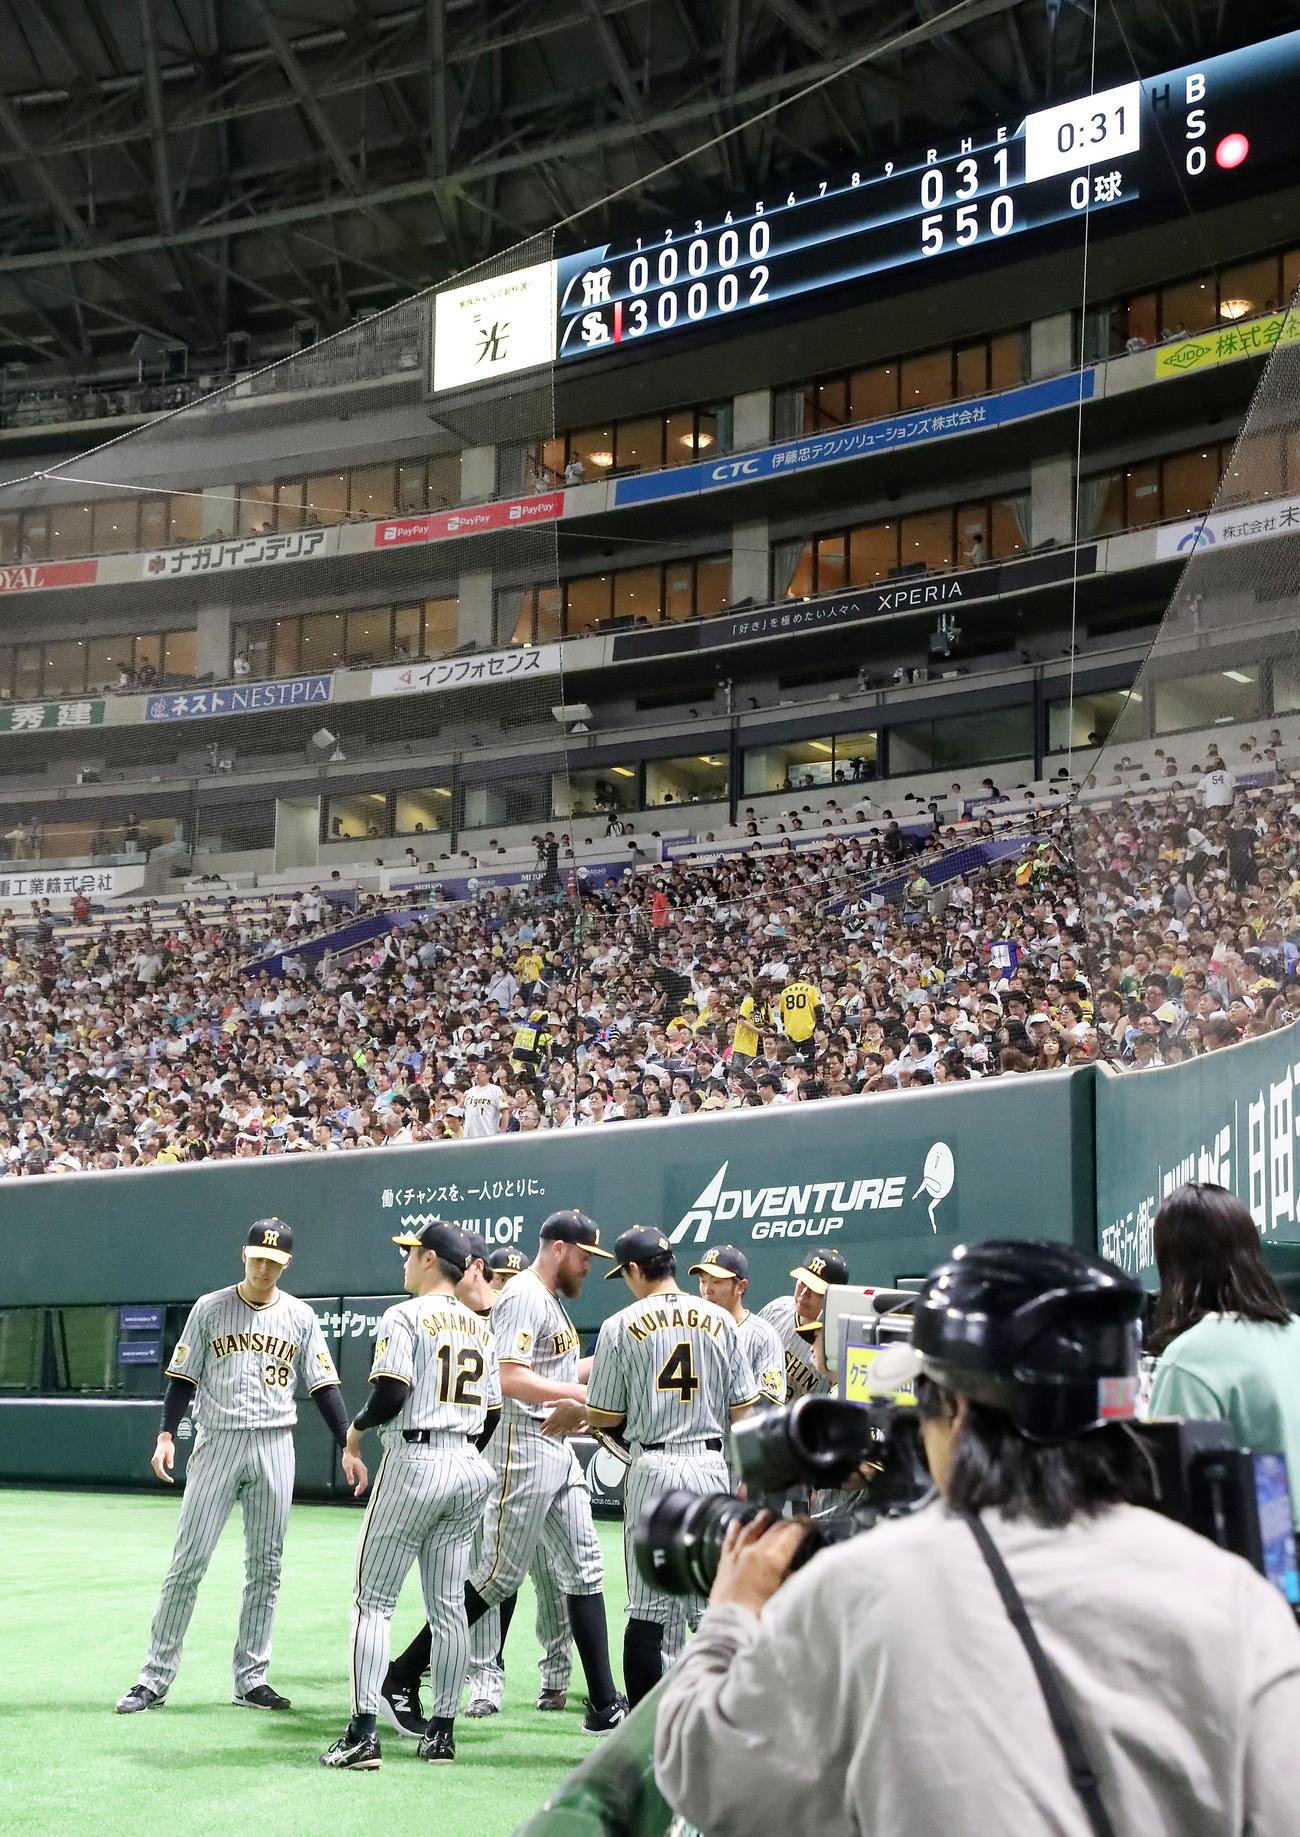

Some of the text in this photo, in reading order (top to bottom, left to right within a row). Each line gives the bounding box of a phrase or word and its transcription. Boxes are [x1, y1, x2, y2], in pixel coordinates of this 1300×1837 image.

[1186, 74, 1206, 104] B
[1057, 106, 1126, 153] 0:31
[1186, 110, 1206, 139] S
[636, 127, 1007, 252] 1 2 3 4 5 6 7 8 9 R H E
[1169, 347, 1205, 366] FUDO
[771, 406, 986, 470] 伊藤忠テクノソリューションズ株式会社
[711, 458, 761, 481] CTC
[459, 513, 492, 528] PayPay
[522, 502, 555, 517] PayPay
[397, 524, 430, 538] PayPay
[171, 532, 325, 574] ナガノインテリア
[877, 581, 963, 611] XPERIA
[419, 651, 541, 686] インフォセンス
[171, 680, 327, 717] ネスト NESTPIA
[1211, 772, 1225, 786] 54
[785, 994, 806, 1010] 80
[381, 1178, 546, 1208] 働くチャンスを、一人ひとりに。
[667, 1159, 908, 1245] ADVENTURE
[751, 1216, 845, 1240] GROUP
[627, 1307, 725, 1343] KUMAGAI
[212, 1333, 297, 1362] HANSHIN
[264, 1365, 290, 1388] 38
[436, 1343, 486, 1408] 12
[656, 1341, 700, 1403] 4
